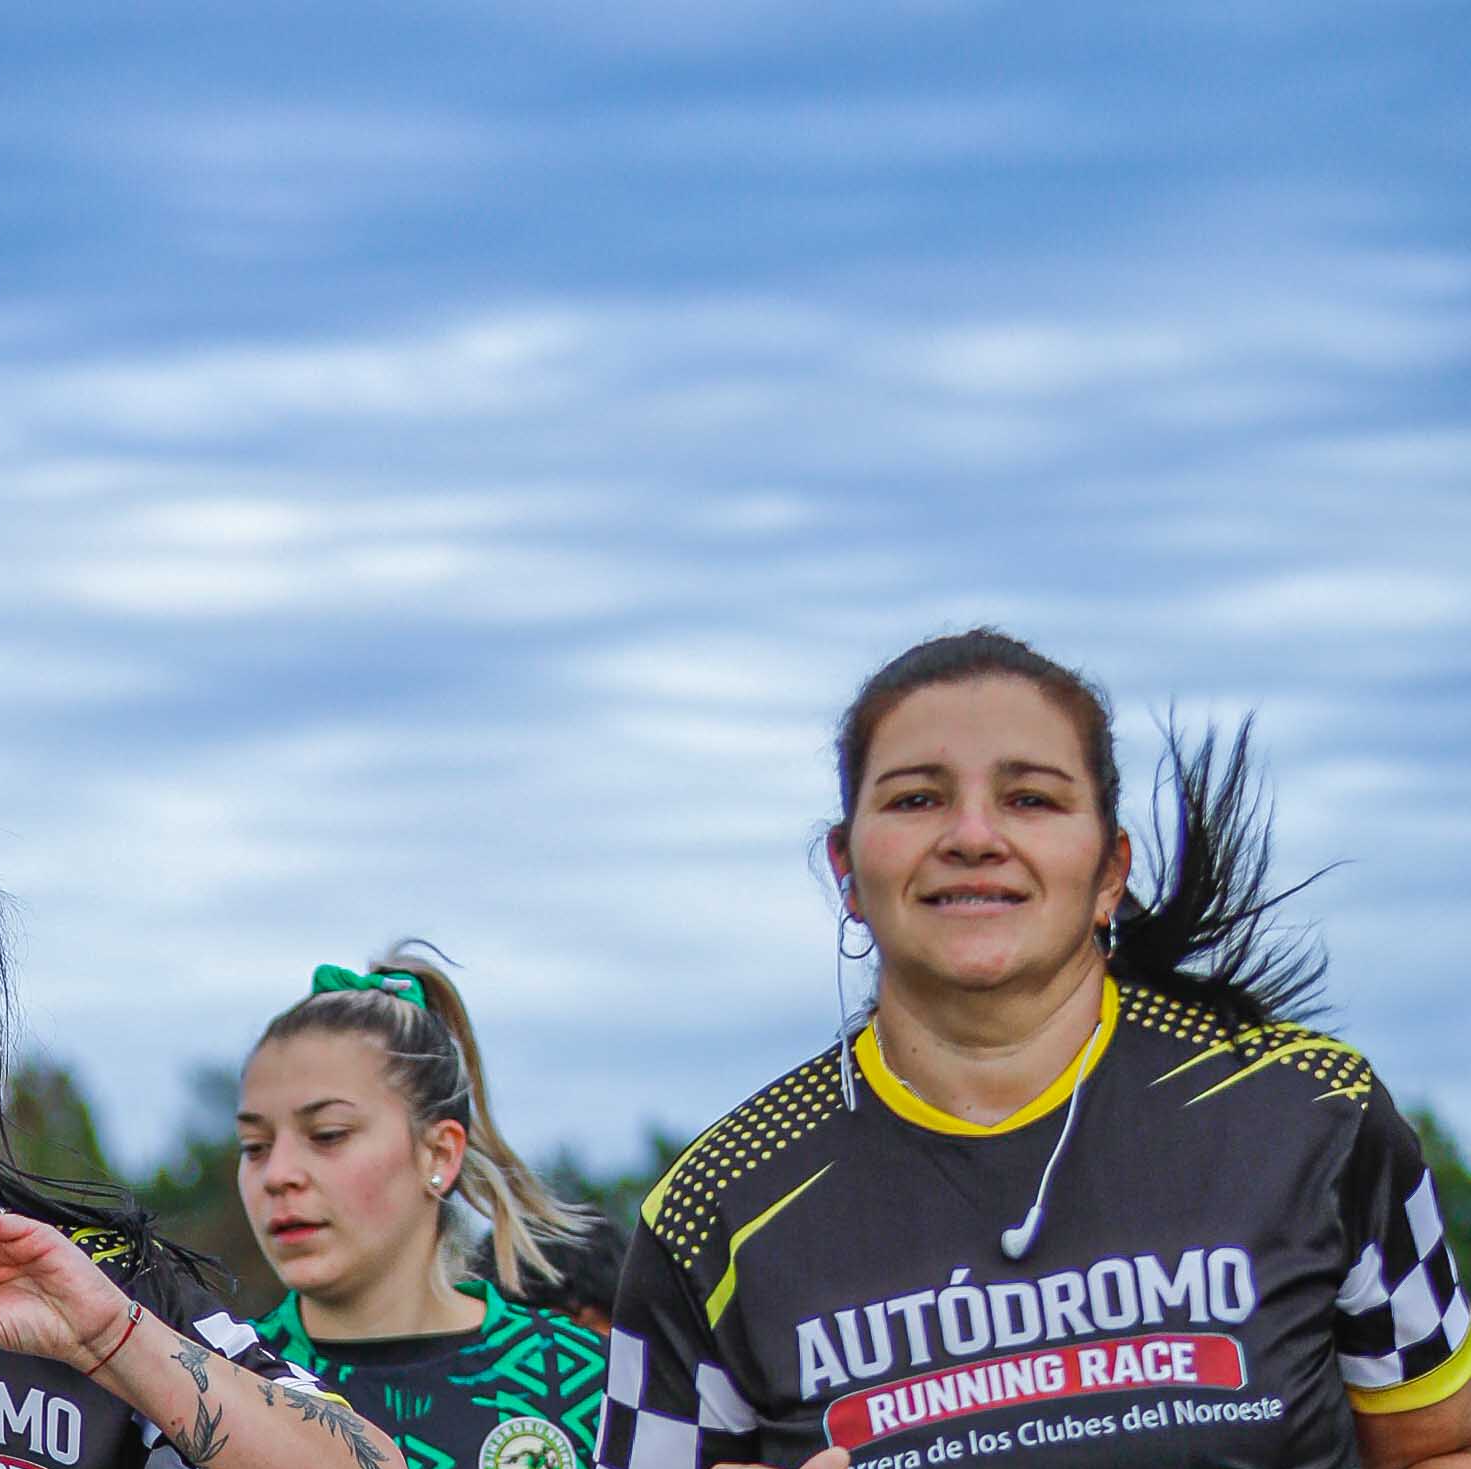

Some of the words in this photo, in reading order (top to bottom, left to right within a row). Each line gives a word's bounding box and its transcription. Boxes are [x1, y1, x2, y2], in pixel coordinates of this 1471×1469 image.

[796, 1246, 1257, 1401] AUTÓDROMO
[866, 1353, 1066, 1435] RUNNING
[1079, 1341, 1198, 1387] RACE
[927, 1435, 964, 1464] de
[968, 1430, 1013, 1456] los
[1016, 1414, 1117, 1447] Clubes
[1121, 1400, 1169, 1432] del
[1172, 1396, 1284, 1425] Noroeste
